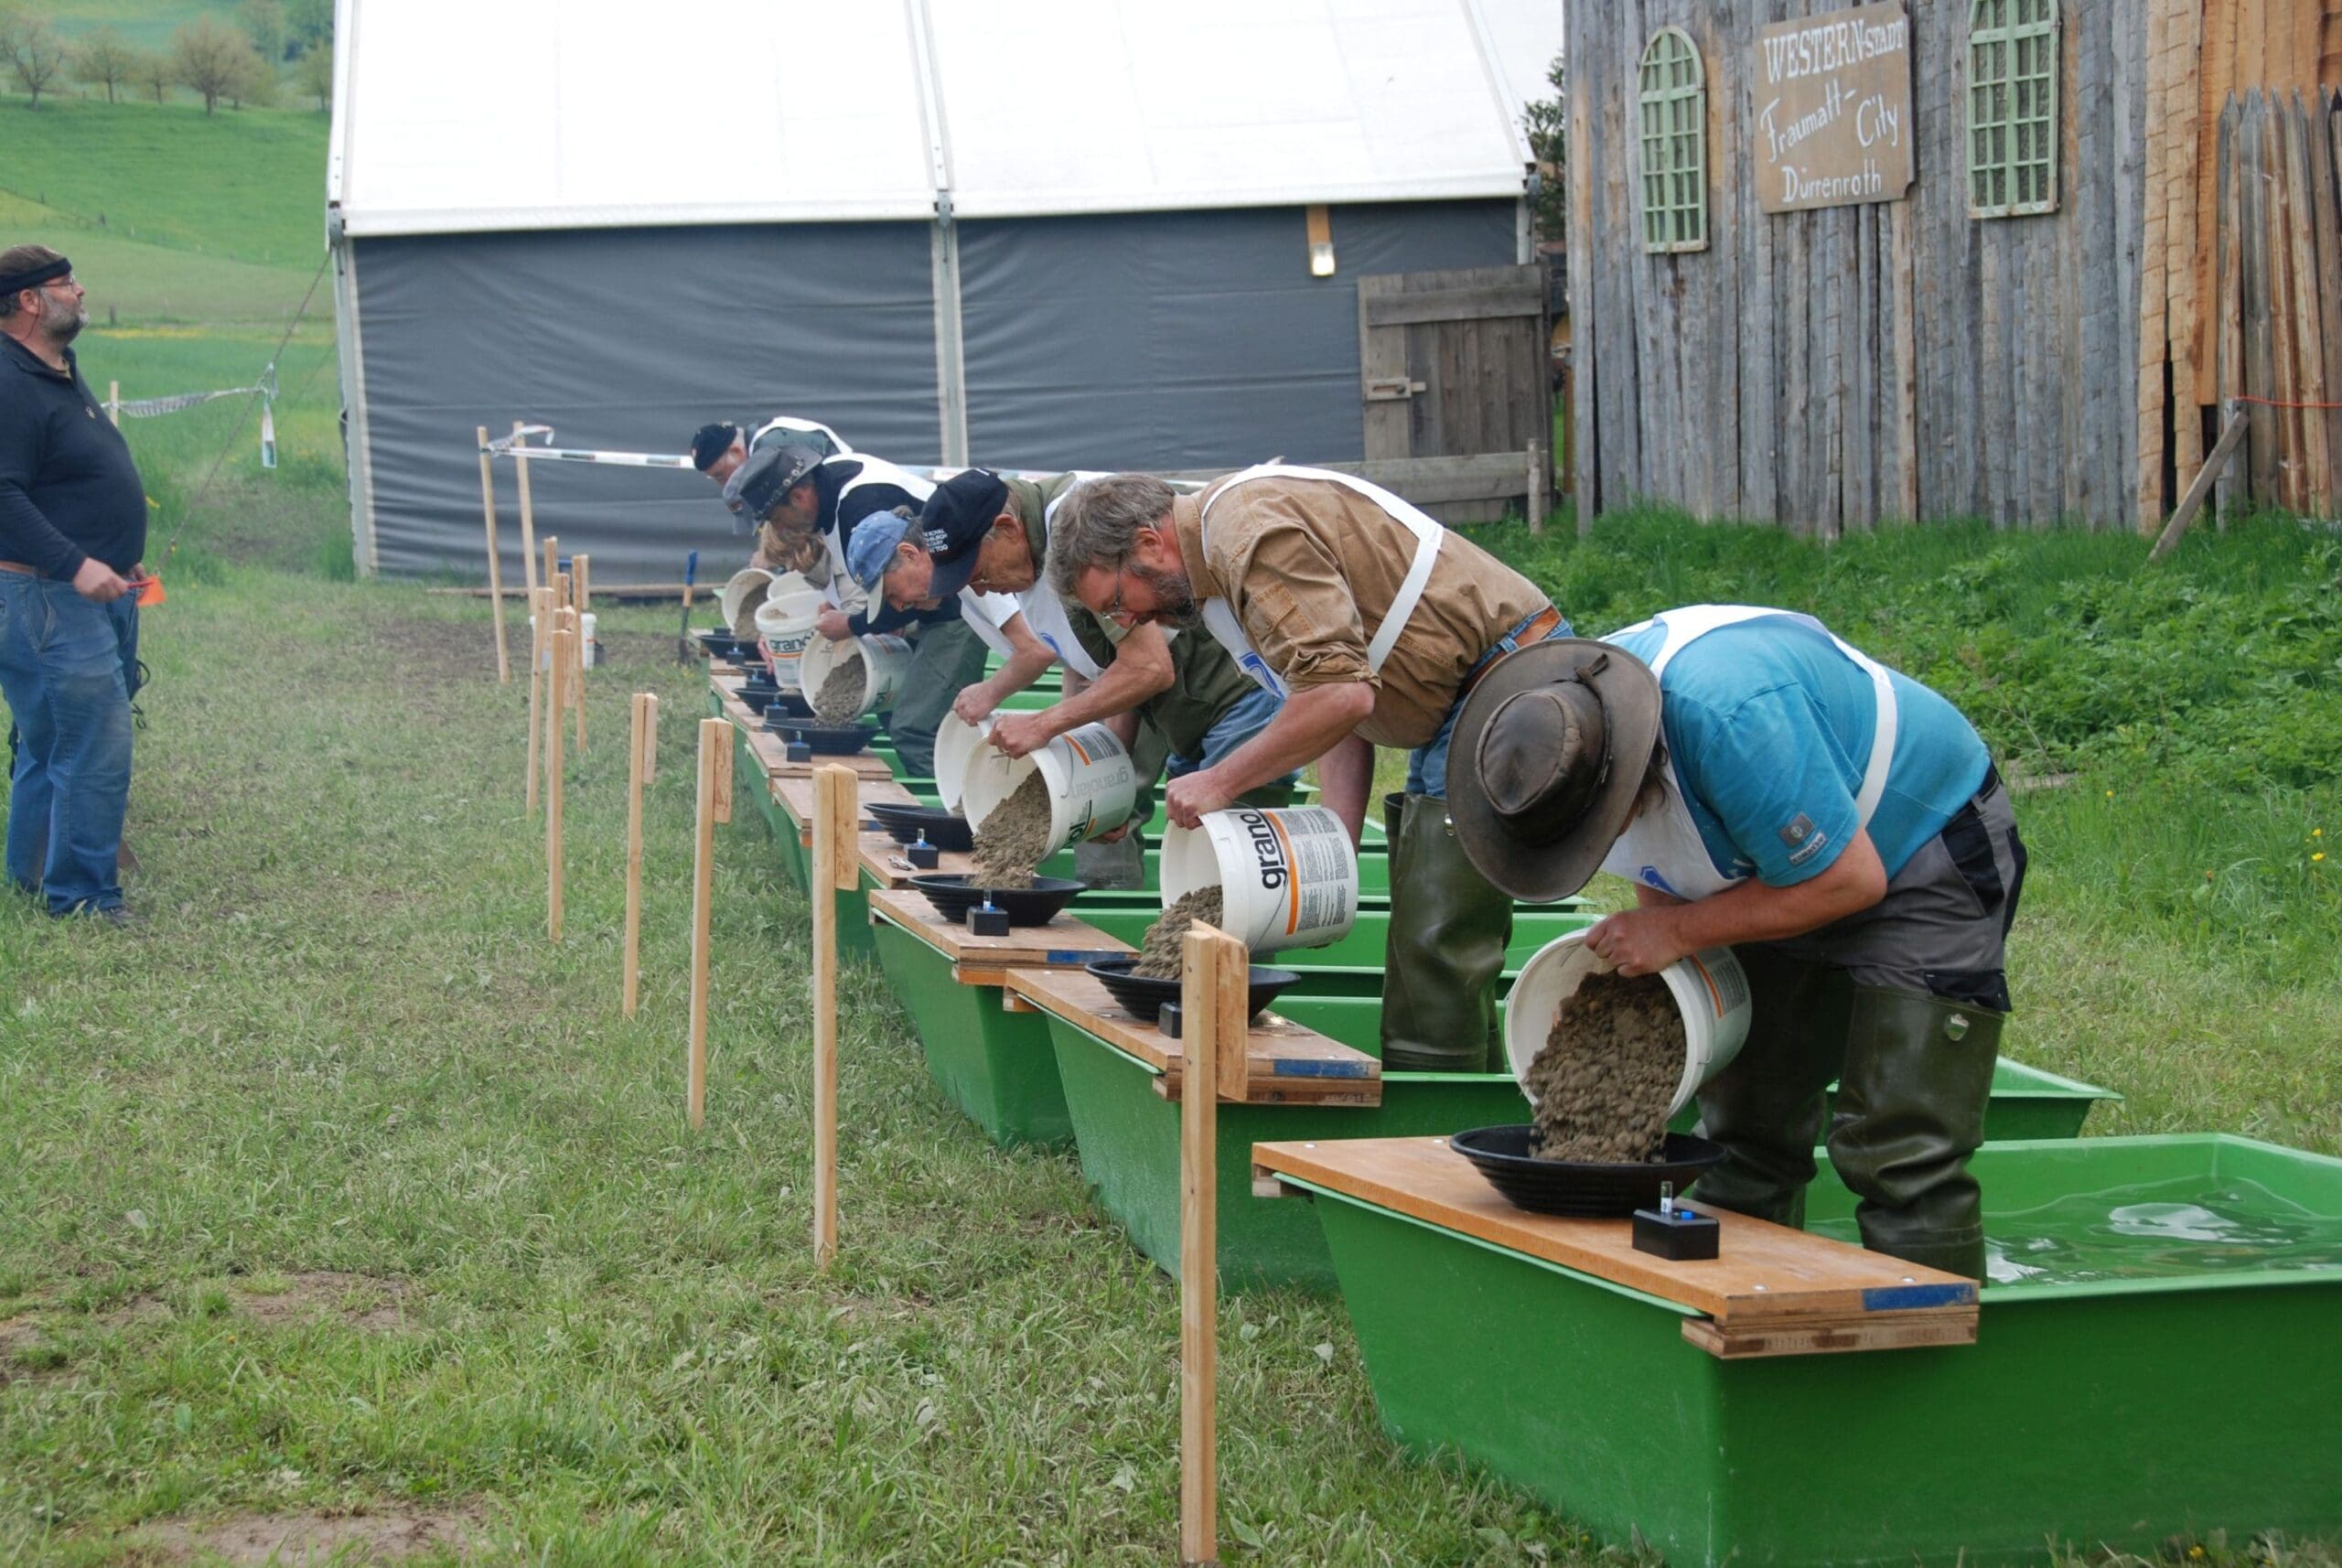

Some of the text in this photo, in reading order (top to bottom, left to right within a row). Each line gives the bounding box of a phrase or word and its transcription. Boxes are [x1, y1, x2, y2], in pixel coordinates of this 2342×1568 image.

[1856, 93, 1898, 147] City
[1782, 158, 1882, 203] Dürrenroth
[1240, 812, 1289, 889] grano
[1792, 833, 1826, 865] KOMATSU
